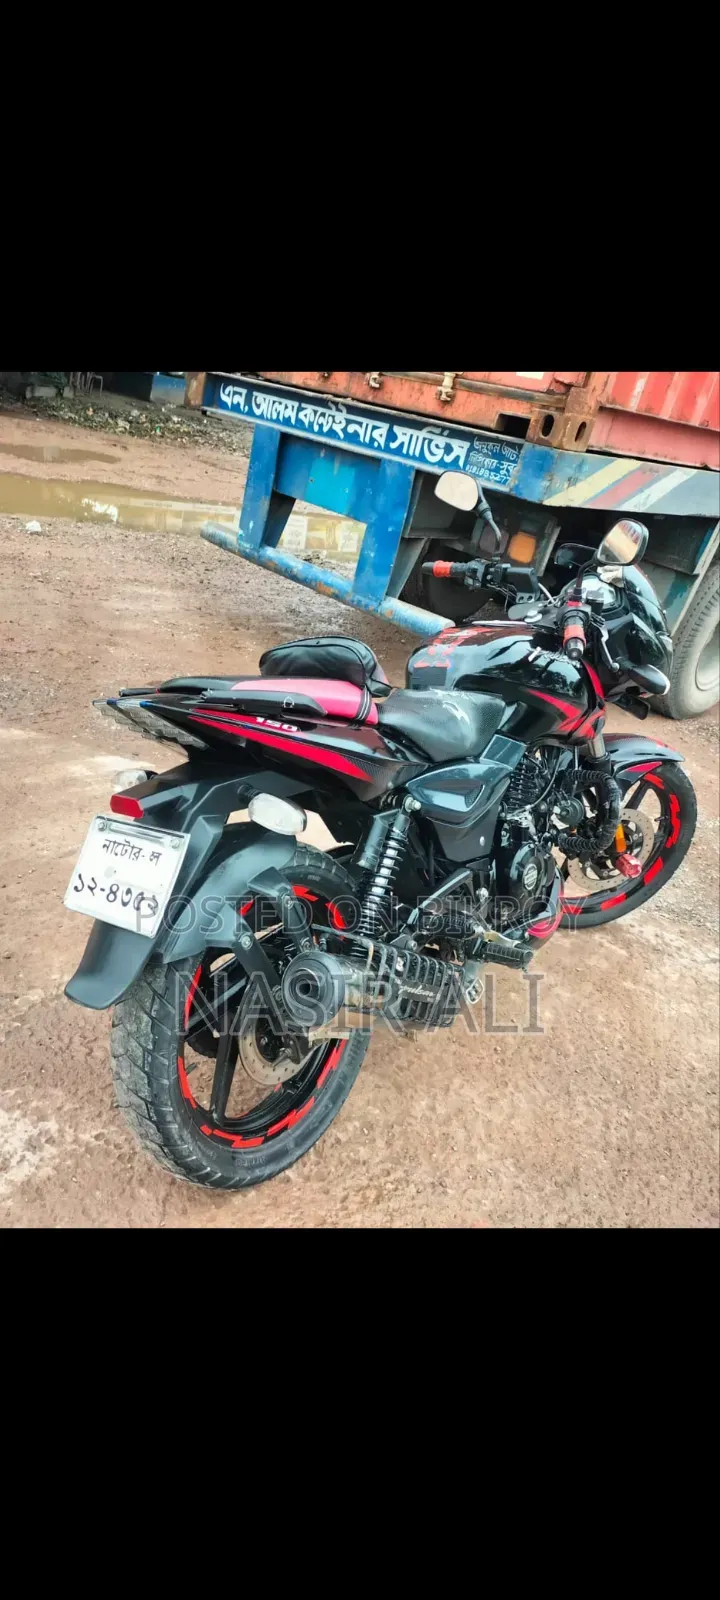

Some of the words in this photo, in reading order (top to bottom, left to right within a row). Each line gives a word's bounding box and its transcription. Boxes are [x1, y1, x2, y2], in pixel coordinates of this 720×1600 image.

[252, 391, 299, 426] আলম
[389, 425, 470, 469] সার্ভিস
[255, 716, 298, 732] 150
